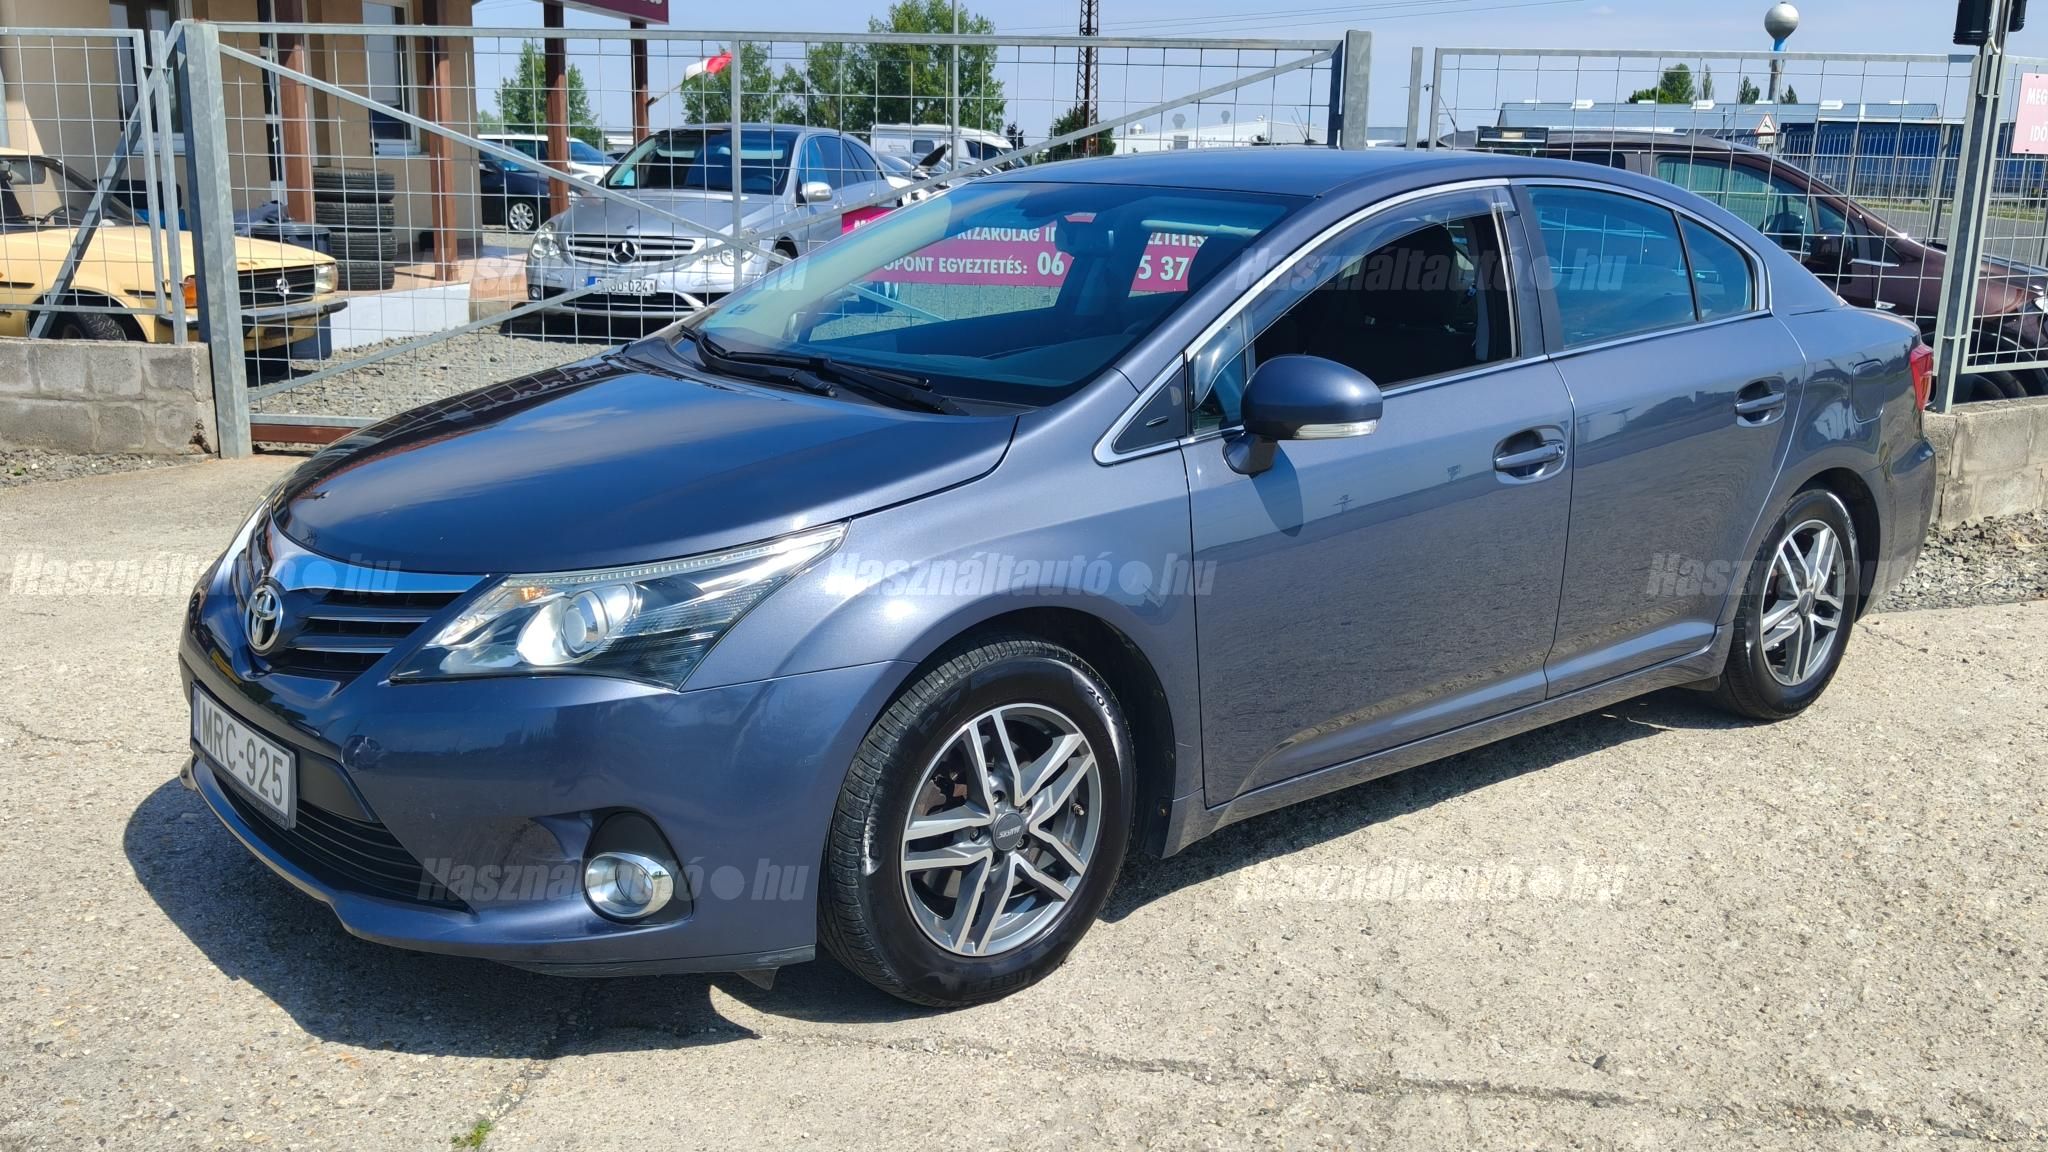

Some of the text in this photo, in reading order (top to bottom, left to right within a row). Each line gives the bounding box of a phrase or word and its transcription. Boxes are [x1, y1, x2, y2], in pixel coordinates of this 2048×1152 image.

[939, 255, 1028, 275] EGYEZTETÉS:
[1037, 251, 1065, 276] 06
[1160, 256, 1189, 281] 37
[202, 701, 283, 806] MRC-925
